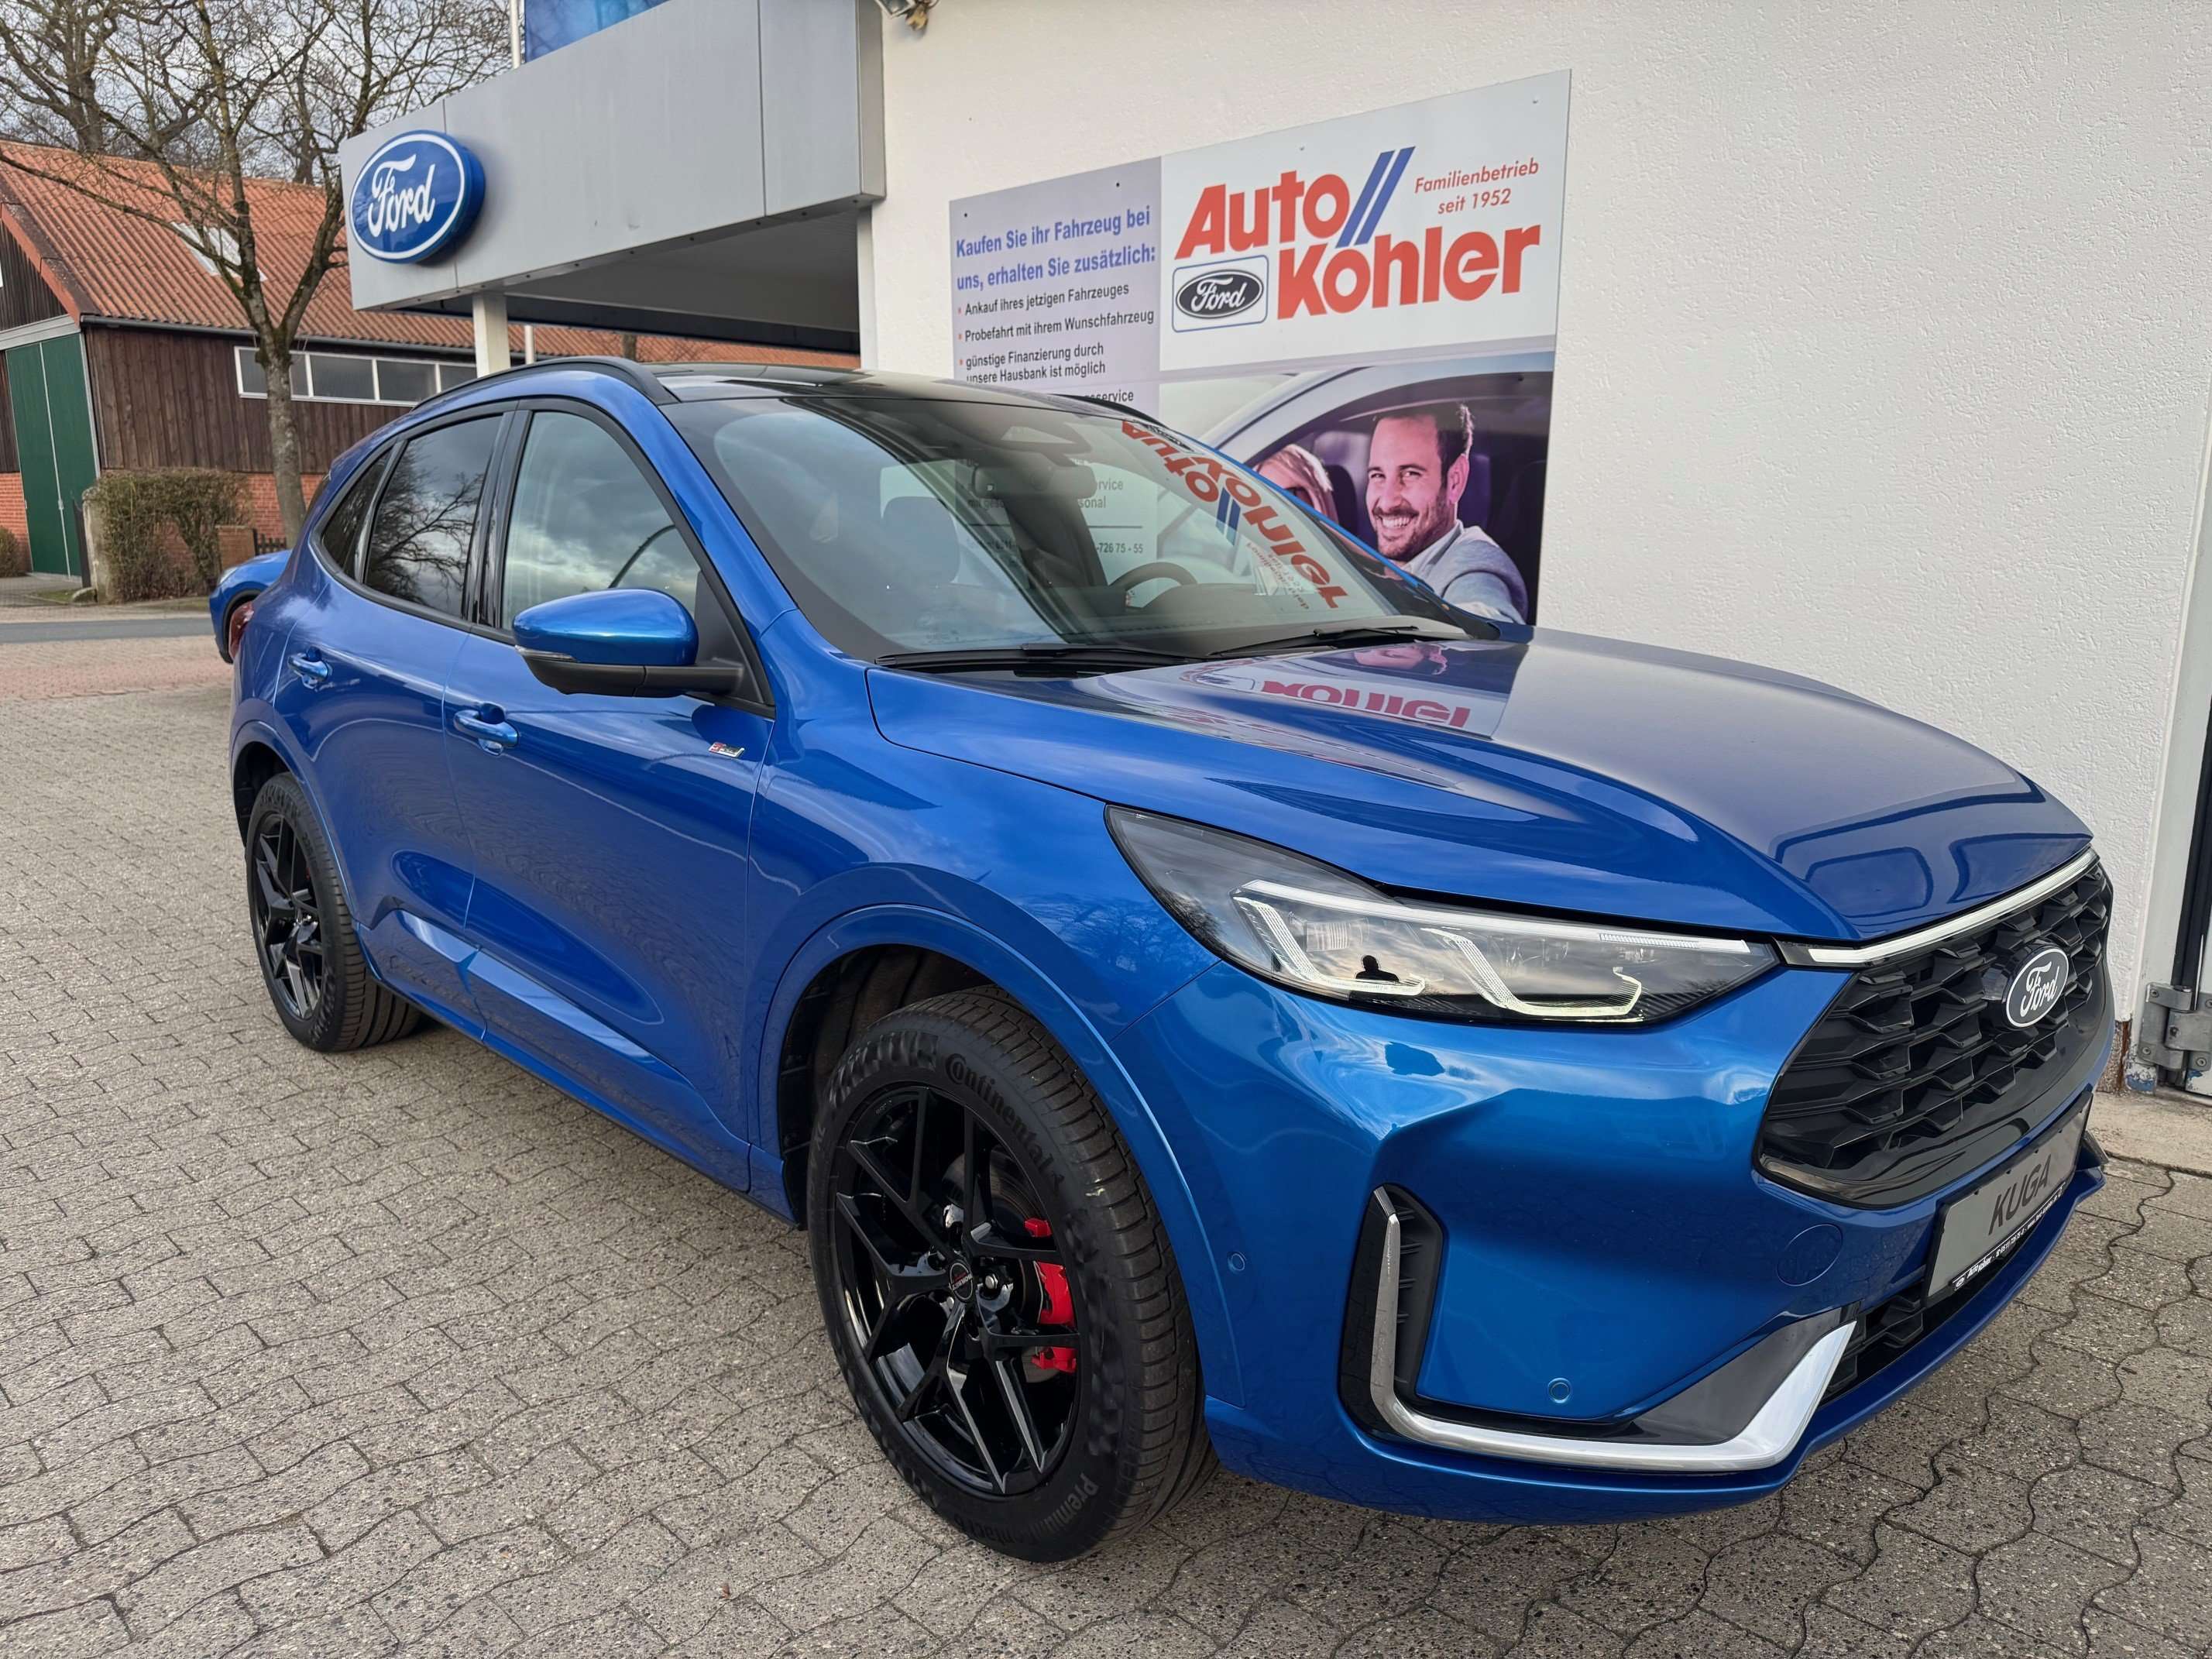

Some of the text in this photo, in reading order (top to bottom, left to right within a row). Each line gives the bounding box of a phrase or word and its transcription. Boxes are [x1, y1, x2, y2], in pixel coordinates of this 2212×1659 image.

[368, 153, 435, 237] Ford
[1415, 158, 1539, 193] Familienbetrieb
[1174, 170, 1350, 259] Auto
[1437, 188, 1511, 215] seit 1952
[957, 204, 1150, 257] Kaufen Sie ihr Fahrzeug bei
[957, 243, 1155, 291] uns, erhalten Sie zusätzlich:
[965, 284, 1129, 315] Ankauf ihres jetzigen Fahrzeuges
[1190, 276, 1245, 311] Ford
[965, 311, 1154, 342] Probefahrt mit ihrem Wunschfahrzeug
[967, 342, 1104, 370] günstige Finanzierung durch
[1000, 366, 1047, 383] Hausbank
[1049, 365, 1062, 378] ist
[1065, 361, 1106, 378] möglich
[2020, 961, 2059, 1017] Ford
[945, 1053, 1054, 1171] Continental
[1988, 1153, 2052, 1236] KUGA
